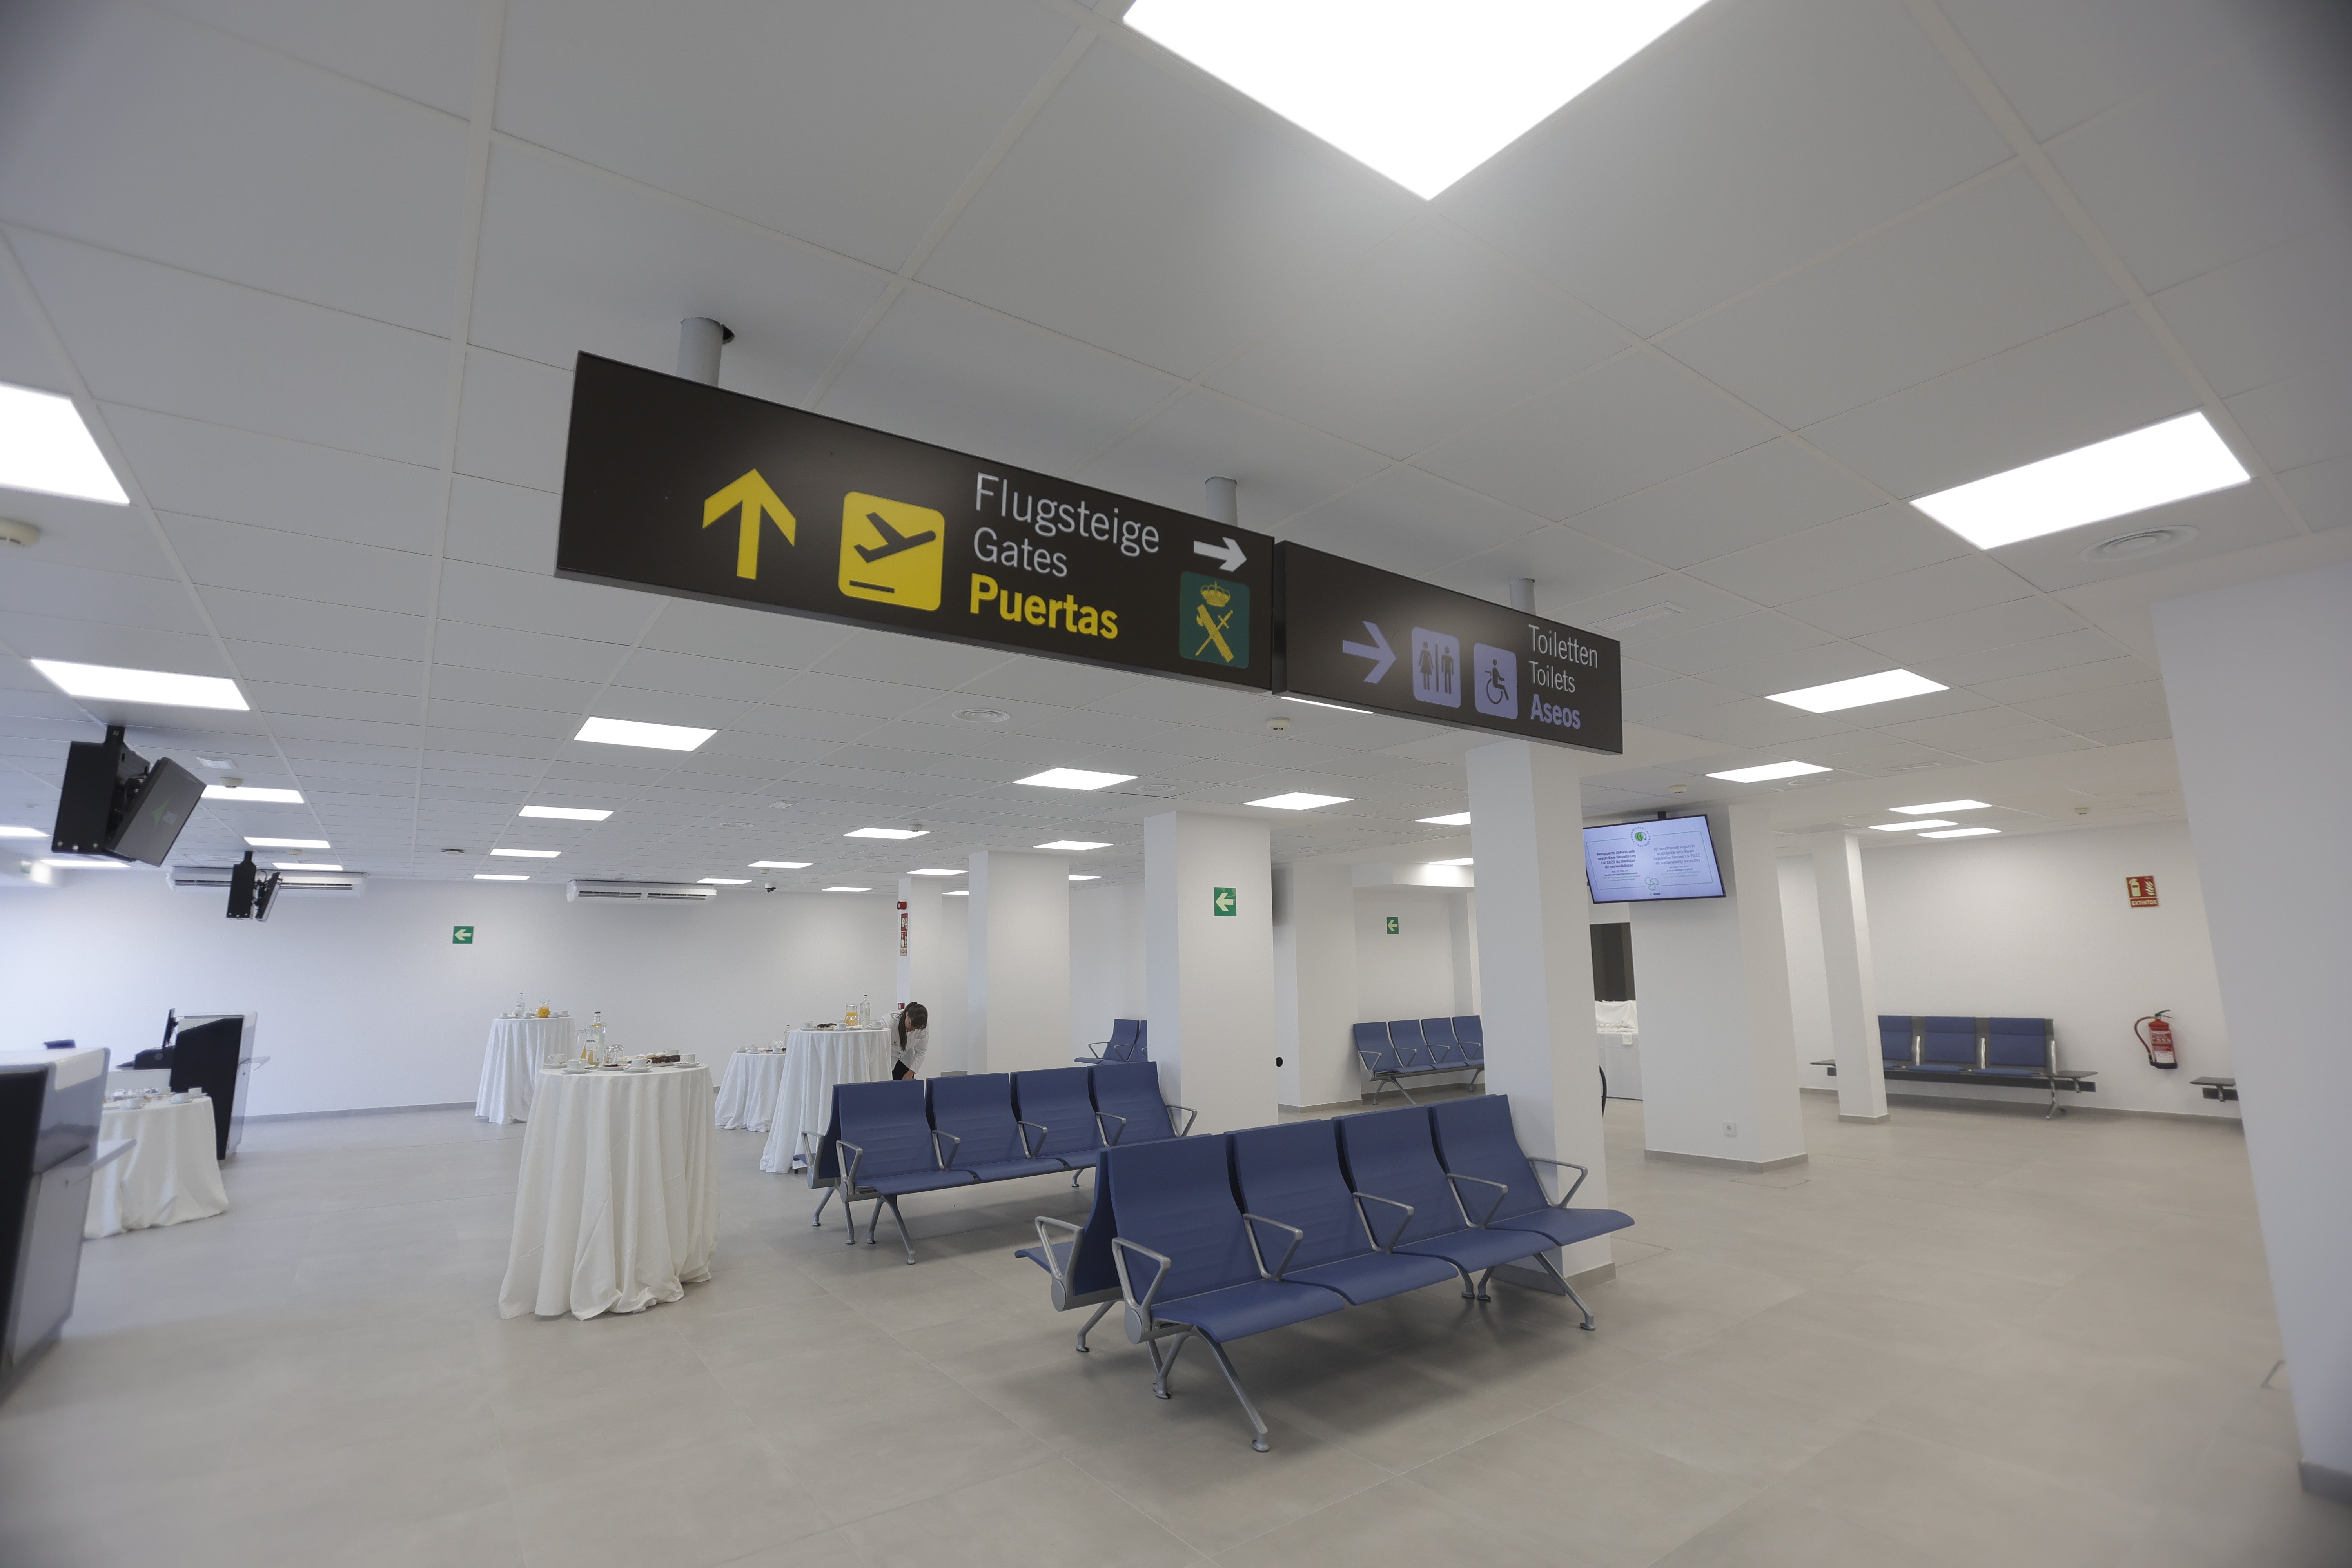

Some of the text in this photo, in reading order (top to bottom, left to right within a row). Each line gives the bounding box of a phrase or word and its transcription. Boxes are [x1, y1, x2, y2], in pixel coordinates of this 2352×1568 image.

[975, 472, 1159, 557] Flugsteige
[974, 527, 1068, 577] Gates
[970, 573, 1118, 639] Puertas
[1528, 624, 1598, 668] Toiletten
[1529, 660, 1575, 693] Toilets
[1530, 693, 1581, 729] Aseos
